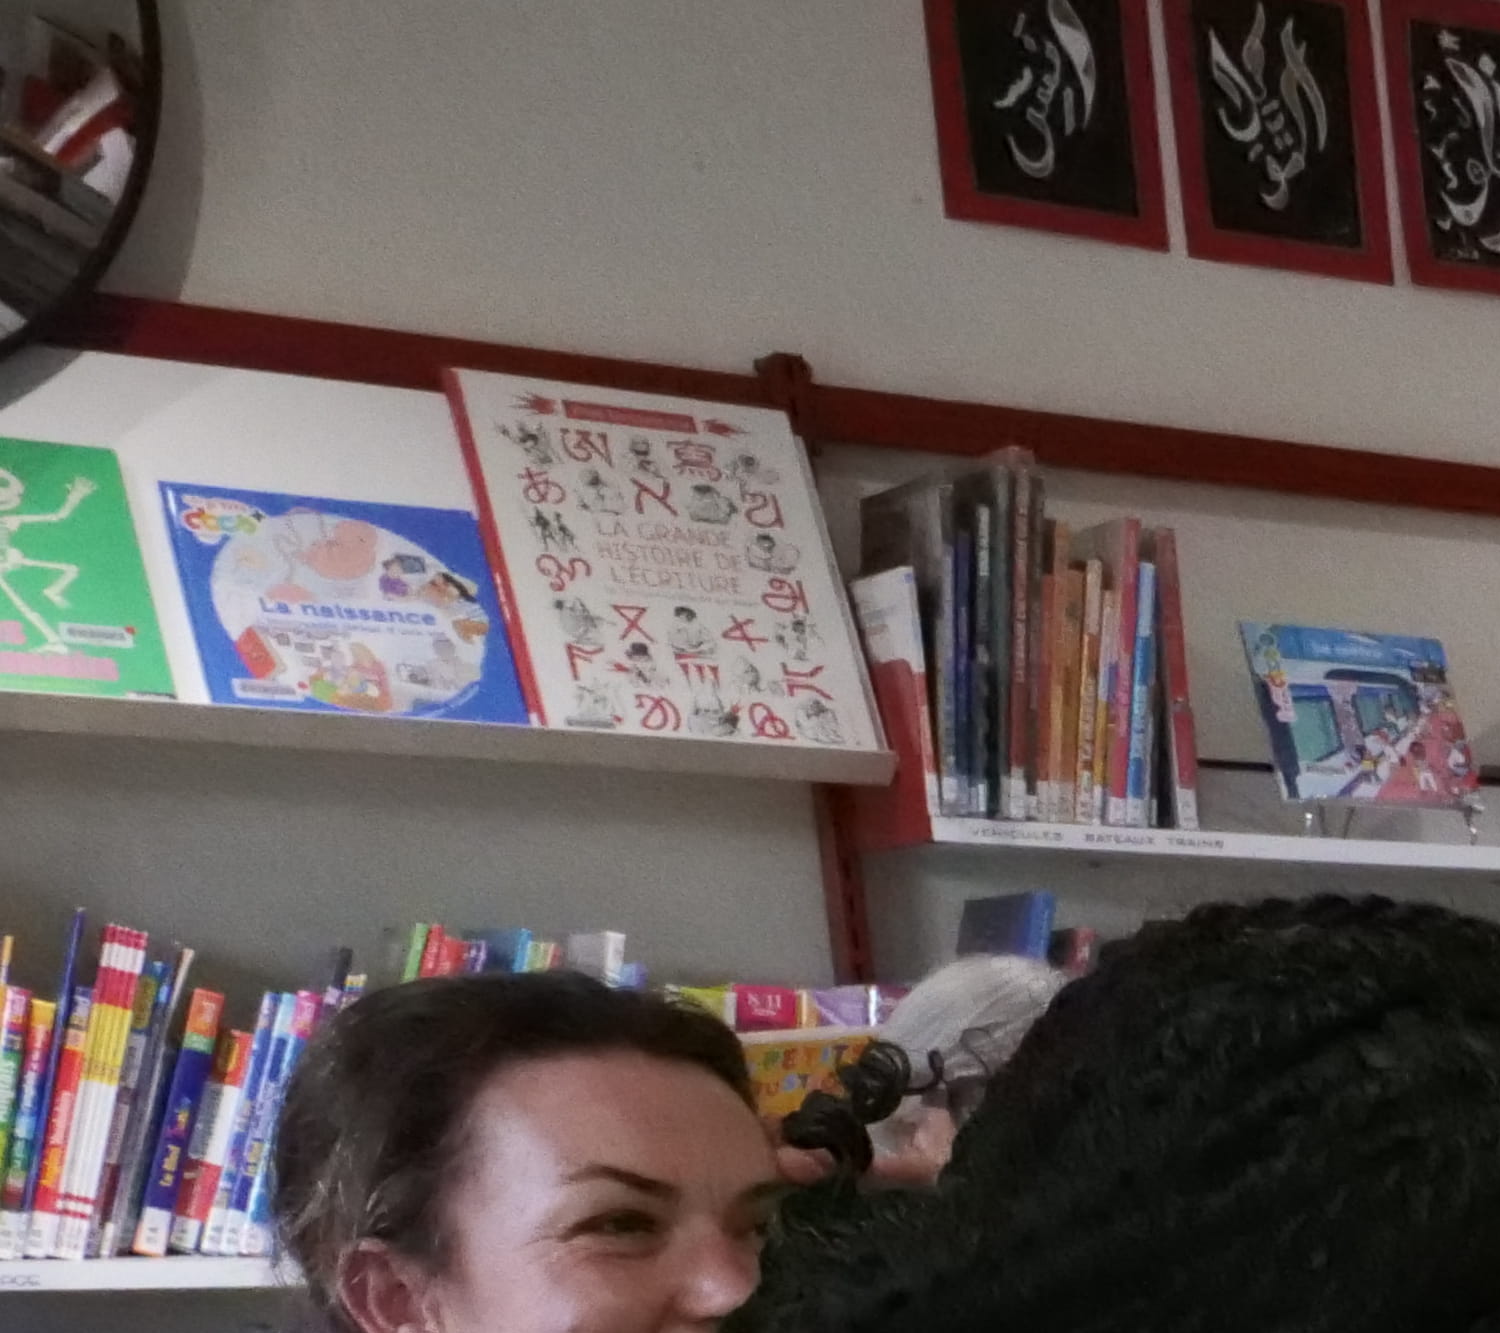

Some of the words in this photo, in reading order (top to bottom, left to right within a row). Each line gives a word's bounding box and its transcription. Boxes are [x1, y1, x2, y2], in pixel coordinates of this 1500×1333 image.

[638, 523, 729, 547] GRANDE
[598, 543, 704, 568] HISTOIRE
[715, 552, 739, 571] DE
[258, 596, 291, 615] La
[301, 601, 437, 626] naissance
